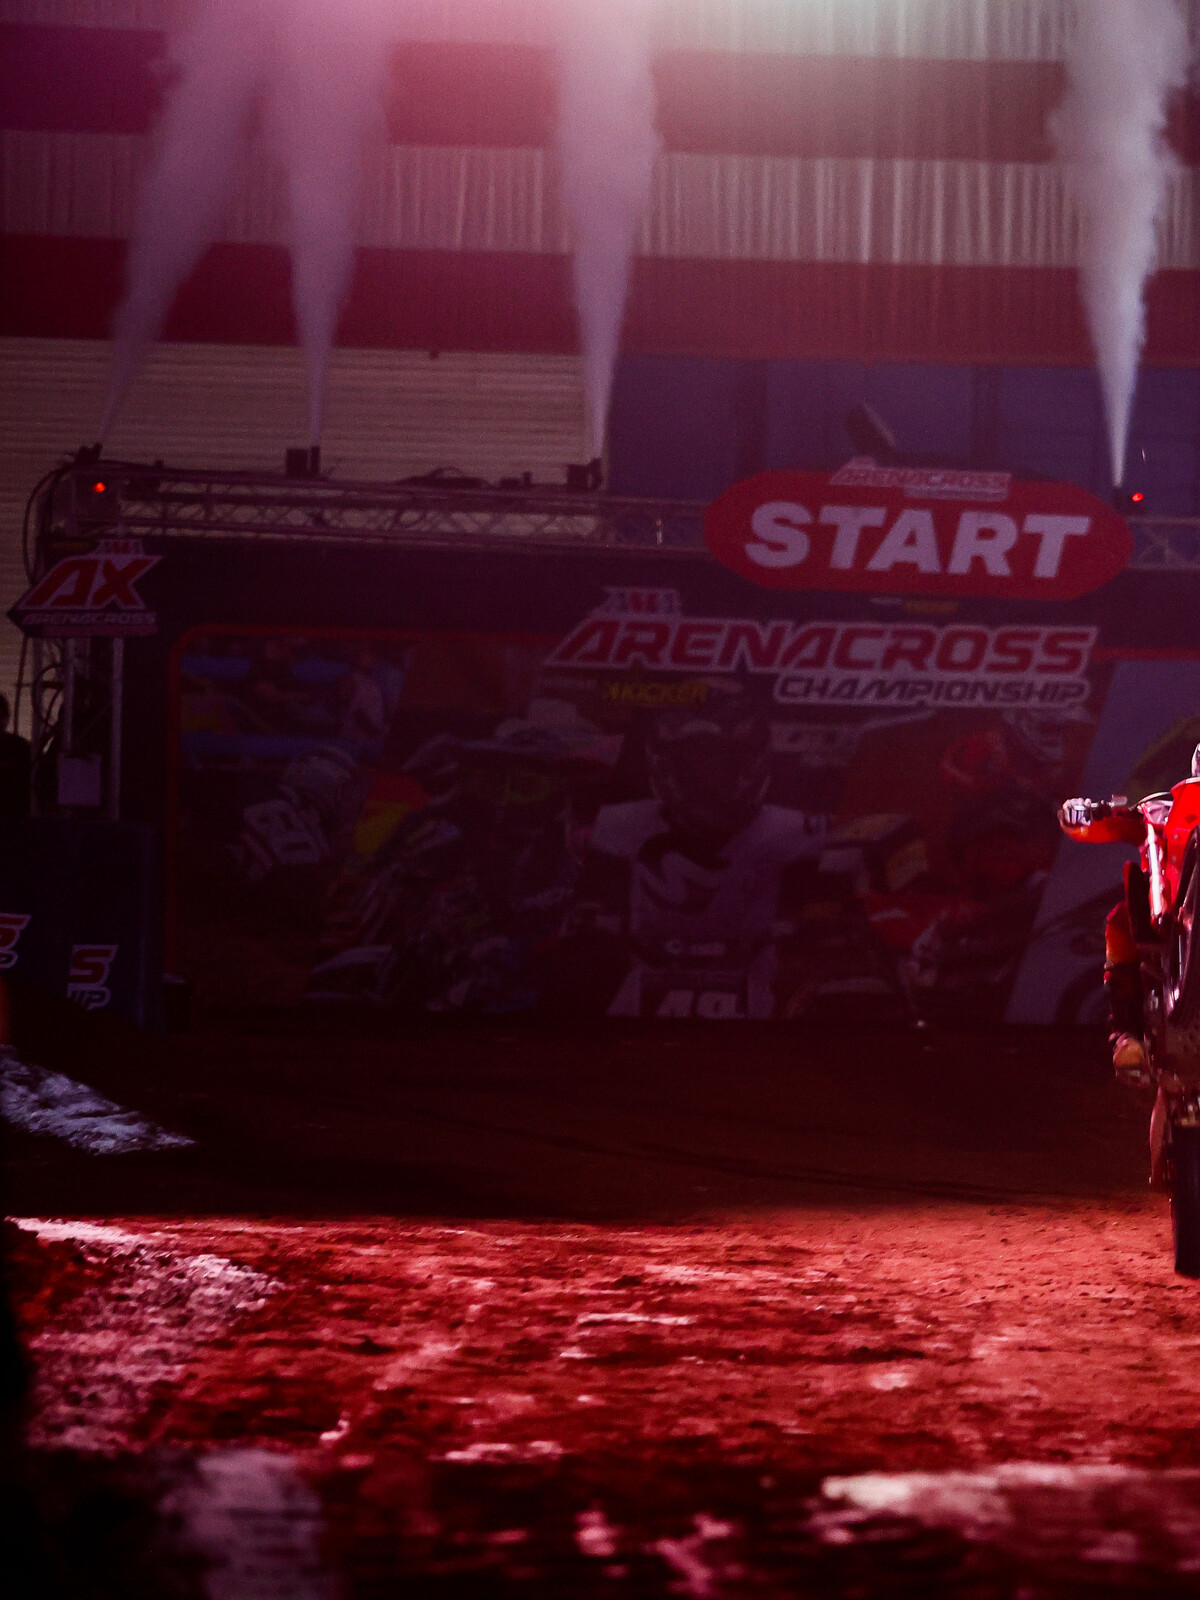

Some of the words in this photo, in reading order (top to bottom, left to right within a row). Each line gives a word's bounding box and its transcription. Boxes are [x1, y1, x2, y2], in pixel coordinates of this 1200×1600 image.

[743, 501, 1092, 578] START
[554, 621, 1092, 674] ARENACROSS
[779, 676, 1088, 704] CHAMPIONSHIP
